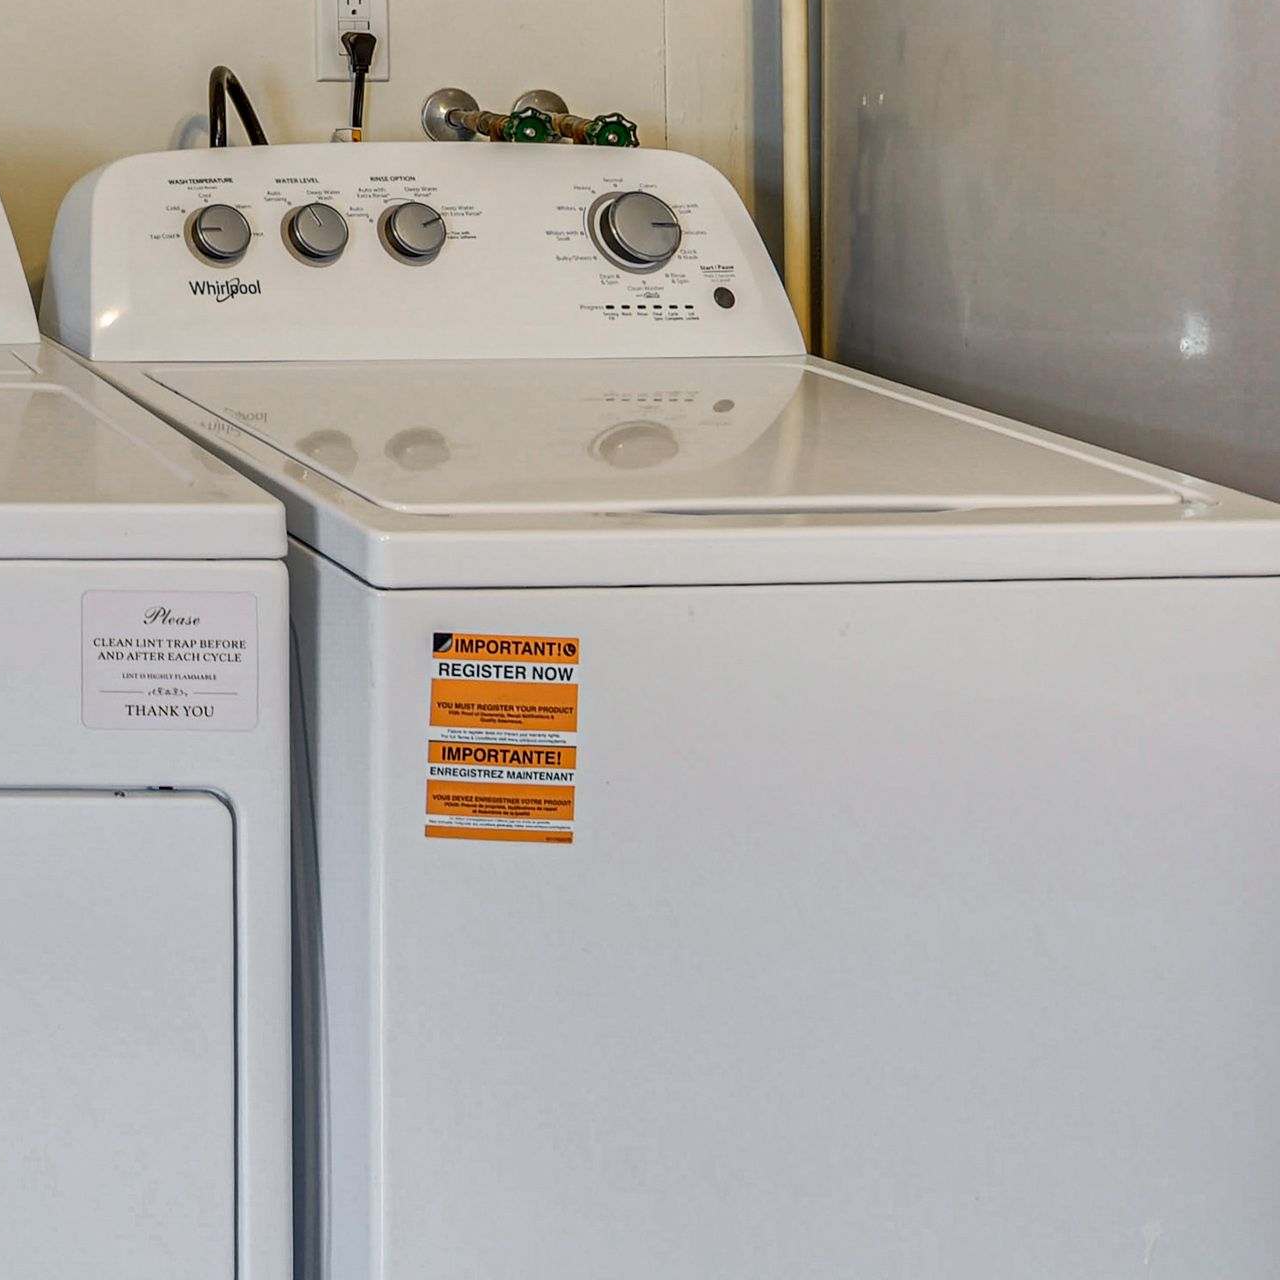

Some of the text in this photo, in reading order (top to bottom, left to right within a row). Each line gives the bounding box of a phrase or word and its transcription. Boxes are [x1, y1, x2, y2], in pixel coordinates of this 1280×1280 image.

[189, 277, 262, 302] Whirlpool
[143, 606, 200, 626] Please
[93, 637, 247, 649] CLEAN LINT TRAP BEFORE
[455, 638, 562, 656] IMPORTANT!
[98, 651, 242, 662] AND AFTER EACH CYCLE
[175, 673, 217, 681] FLAMMABLE
[438, 662, 574, 681] REGISTER NOW
[125, 704, 214, 718] THANK YOU
[477, 703, 514, 711] REGISTER
[538, 706, 574, 714] PRODUCT
[441, 746, 562, 765] IMPORTANTE!
[429, 766, 574, 782] ENREGISTREZ MAINTENANT
[475, 796, 520, 804] ENREGISTRER
